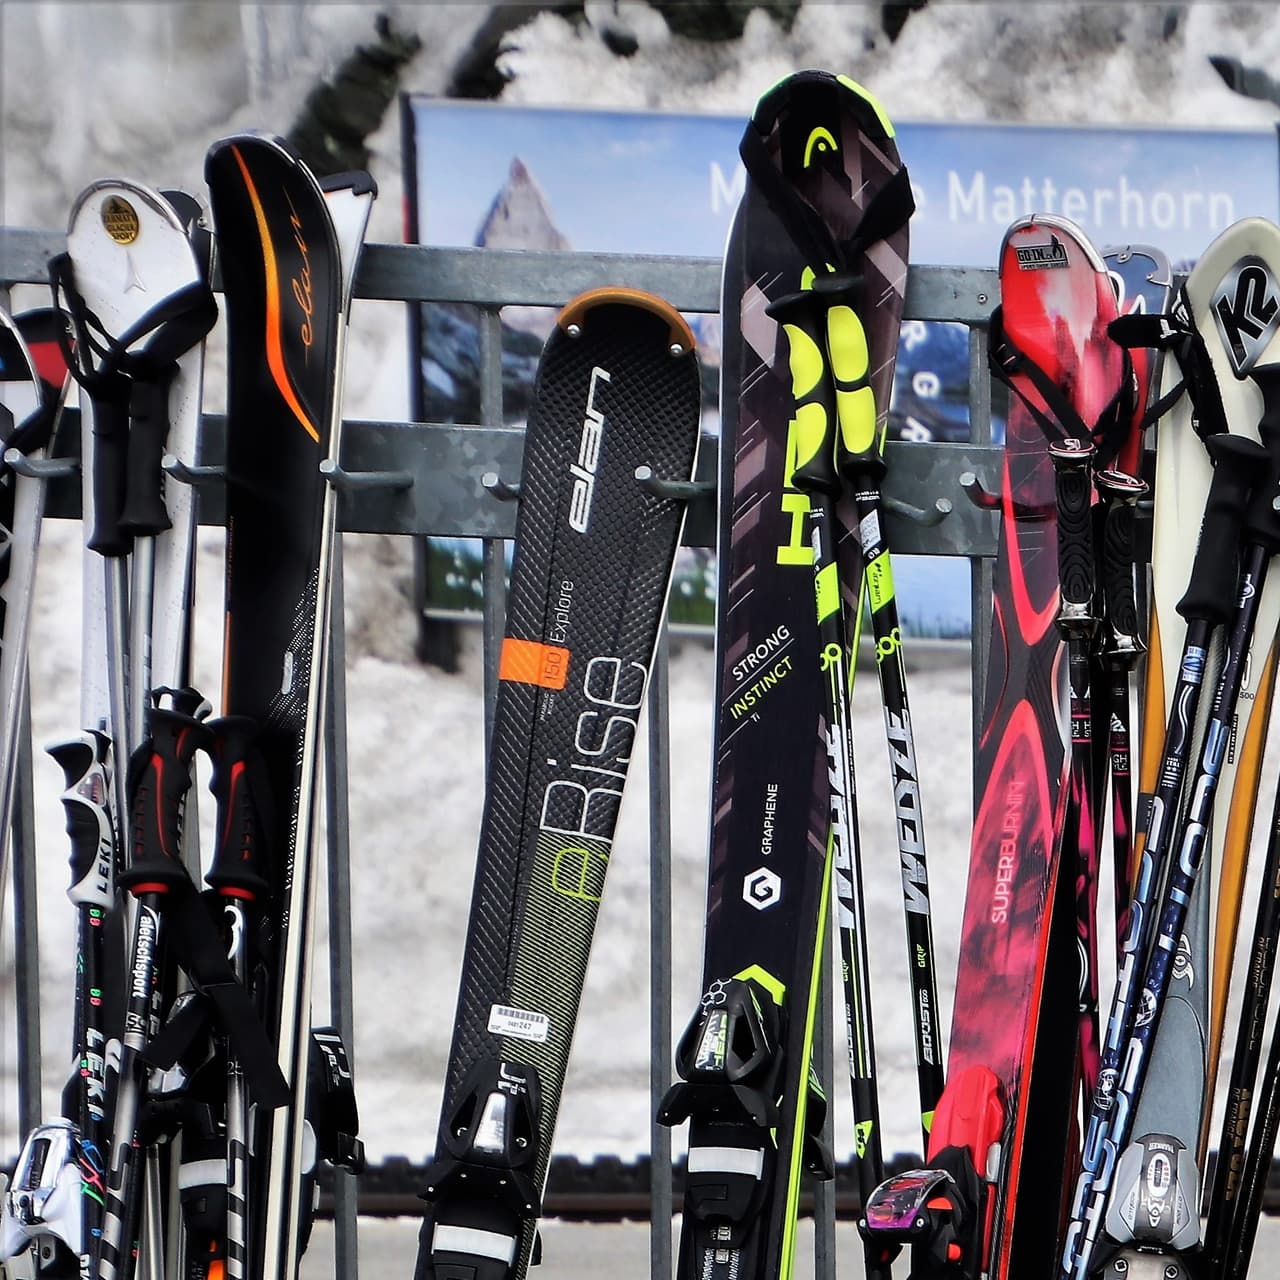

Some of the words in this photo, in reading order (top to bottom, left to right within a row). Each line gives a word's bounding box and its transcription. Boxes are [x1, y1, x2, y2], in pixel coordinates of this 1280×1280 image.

[948, 171, 1236, 229] Matterhorn
[1216, 265, 1280, 371] K2
[567, 366, 611, 535] elan
[549, 579, 574, 643] Explore
[544, 651, 562, 681] 150
[731, 624, 790, 682] STRONG
[729, 655, 793, 720] INSTINCT
[761, 783, 779, 855] GRAPHENE
[97, 838, 113, 895] LEKI
[133, 915, 154, 999] aletschsport
[87, 1026, 106, 1115] LEKI
